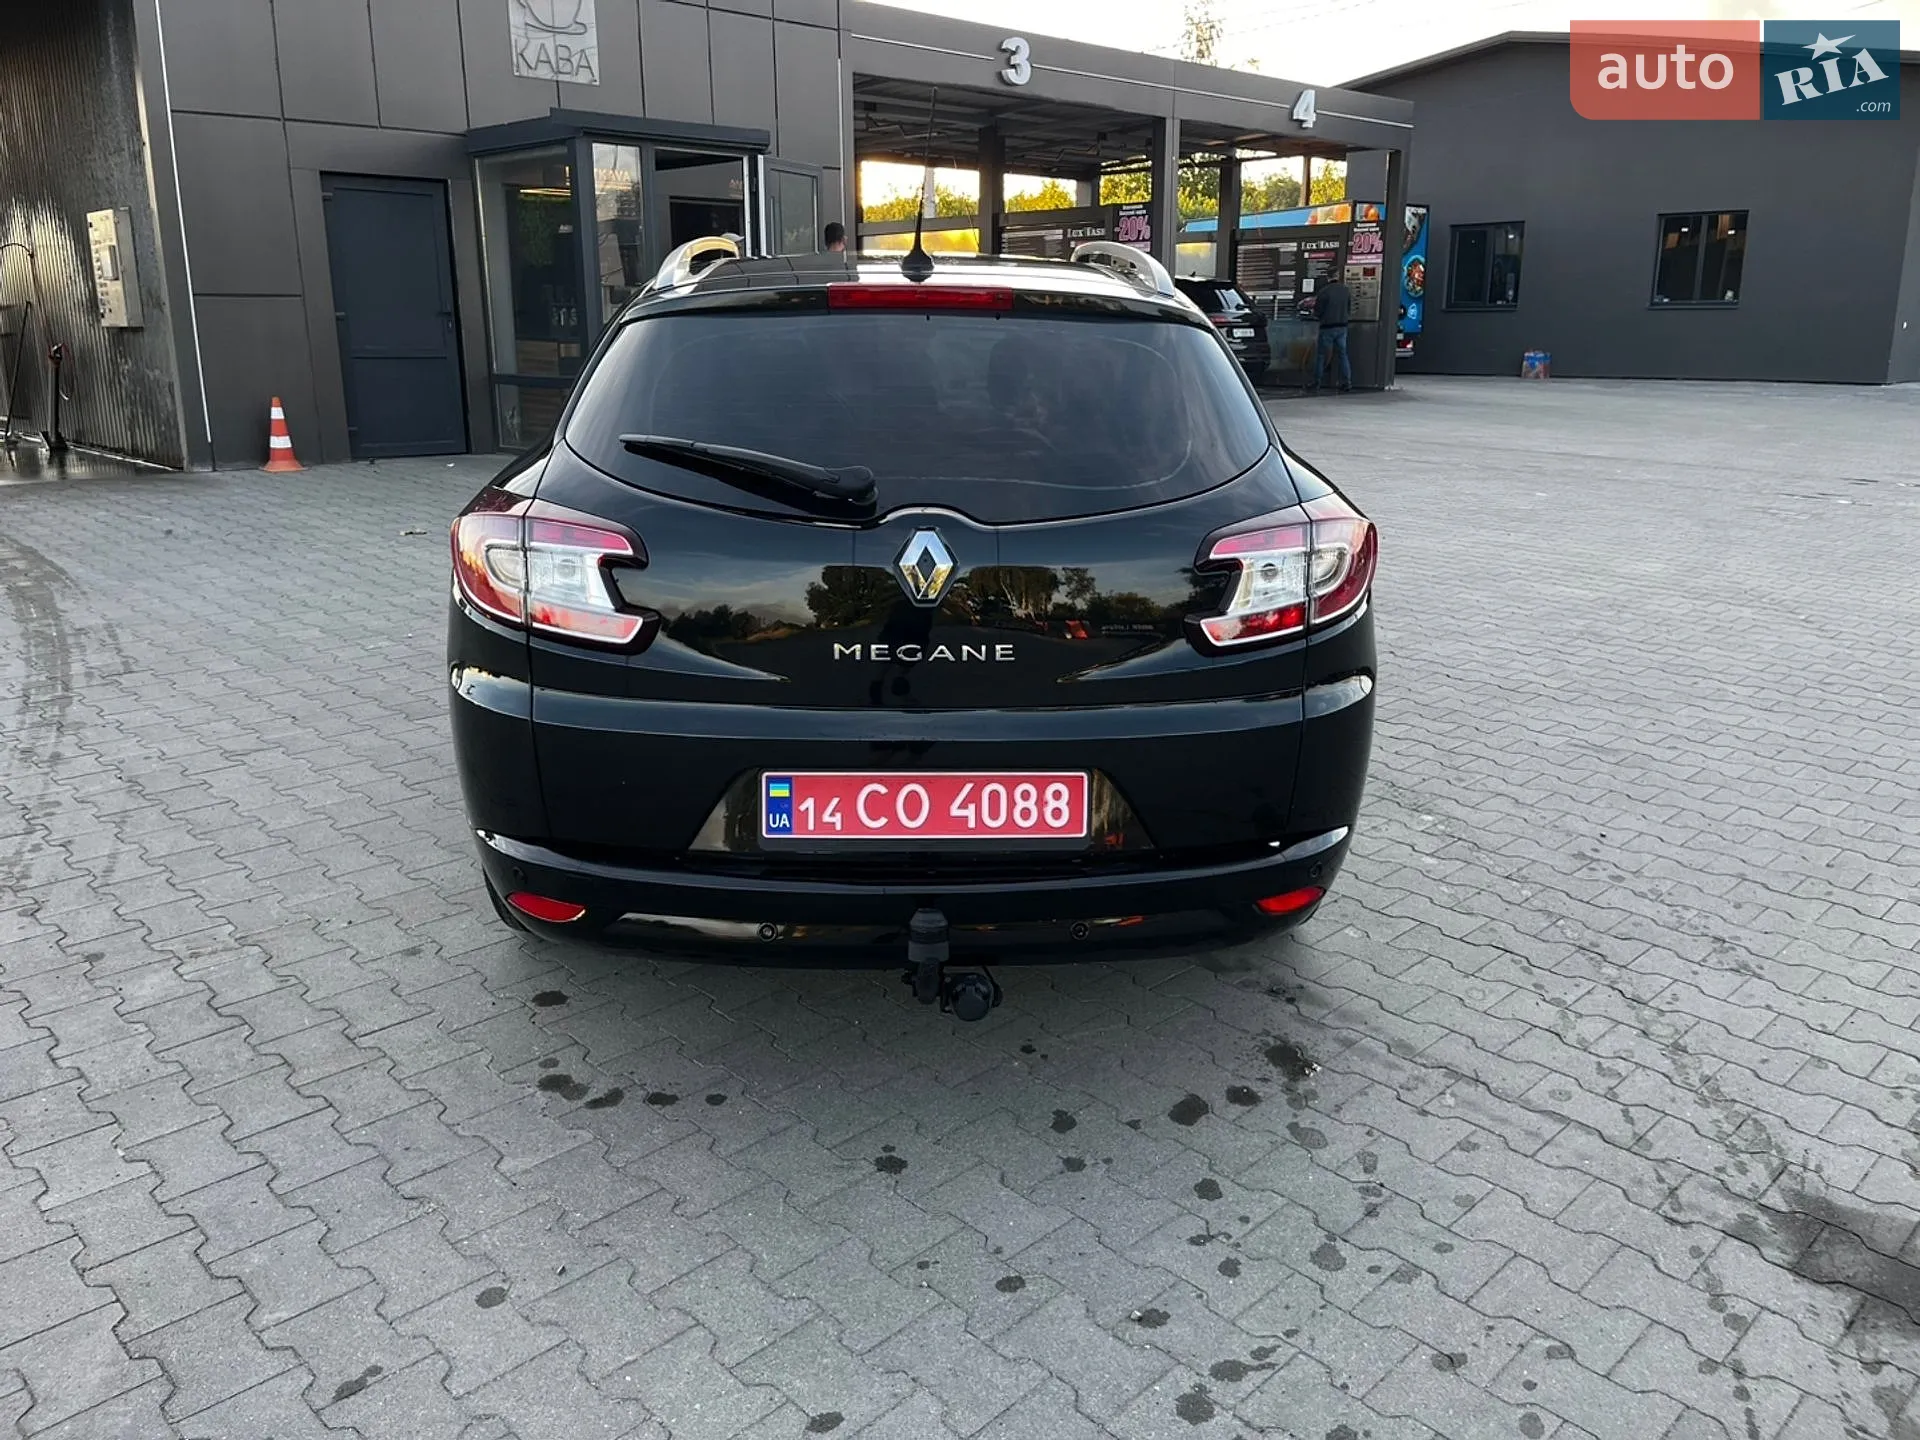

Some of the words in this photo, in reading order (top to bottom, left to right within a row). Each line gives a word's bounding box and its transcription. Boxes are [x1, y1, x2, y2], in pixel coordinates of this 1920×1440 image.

[1000, 36, 1032, 86] 3
[1291, 89, 1317, 129] 4
[833, 642, 1016, 662] MEGANE
[769, 813, 790, 829] UA
[798, 797, 842, 831] 14
[855, 782, 931, 829] CO
[949, 782, 1071, 829] 4088
